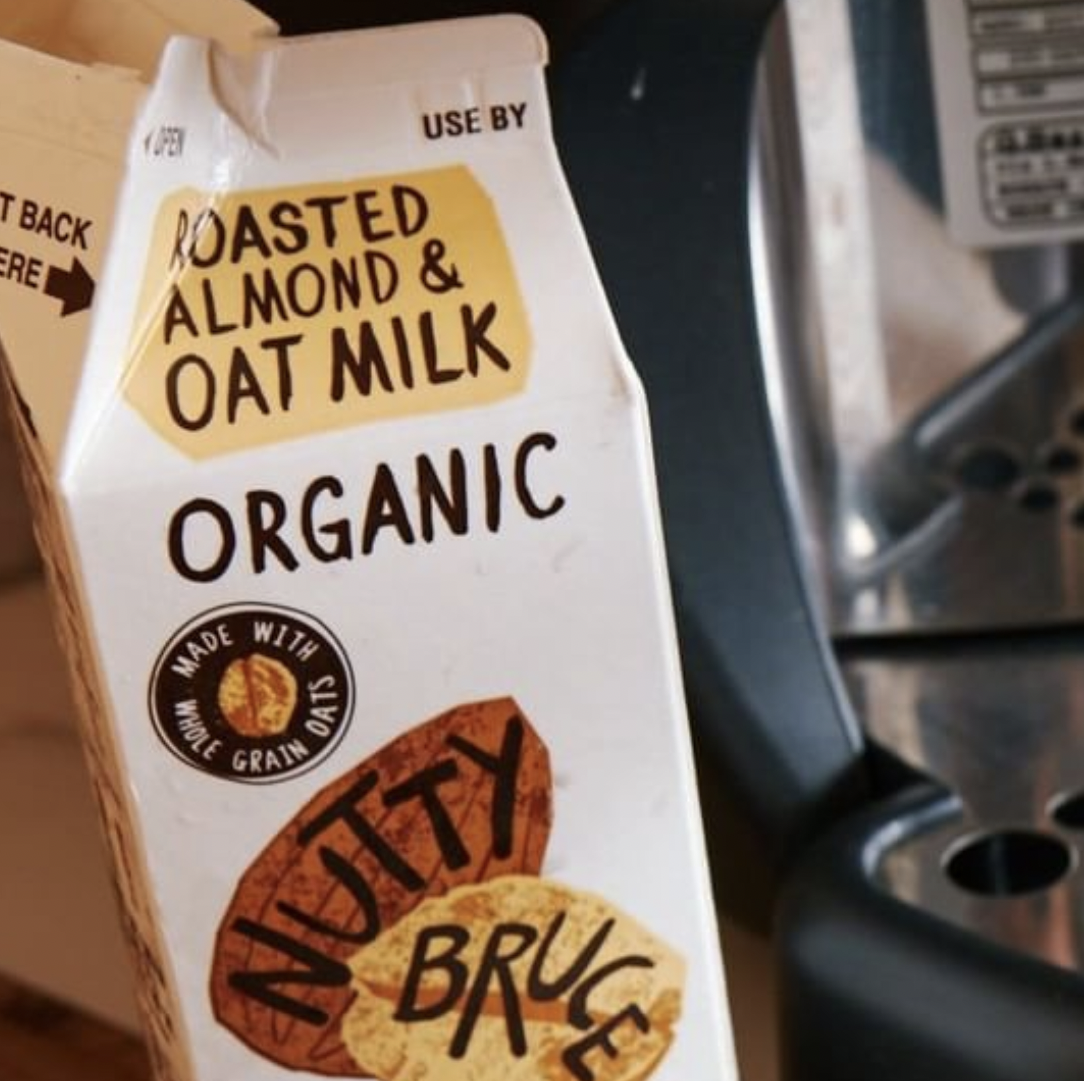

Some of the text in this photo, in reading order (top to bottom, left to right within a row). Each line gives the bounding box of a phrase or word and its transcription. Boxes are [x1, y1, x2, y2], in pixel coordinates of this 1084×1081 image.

[423, 103, 528, 140] USE BY
[19, 199, 93, 250] BACK
[172, 184, 428, 268] ROASTED
[164, 239, 464, 344] ALMOND &
[165, 302, 511, 431] OAT MILK
[168, 432, 565, 582] ORGANIC
[171, 621, 320, 678] MADE WITH
[174, 674, 339, 773] WHOLE GRAIN OATS
[228, 716, 523, 1027] NUTTY
